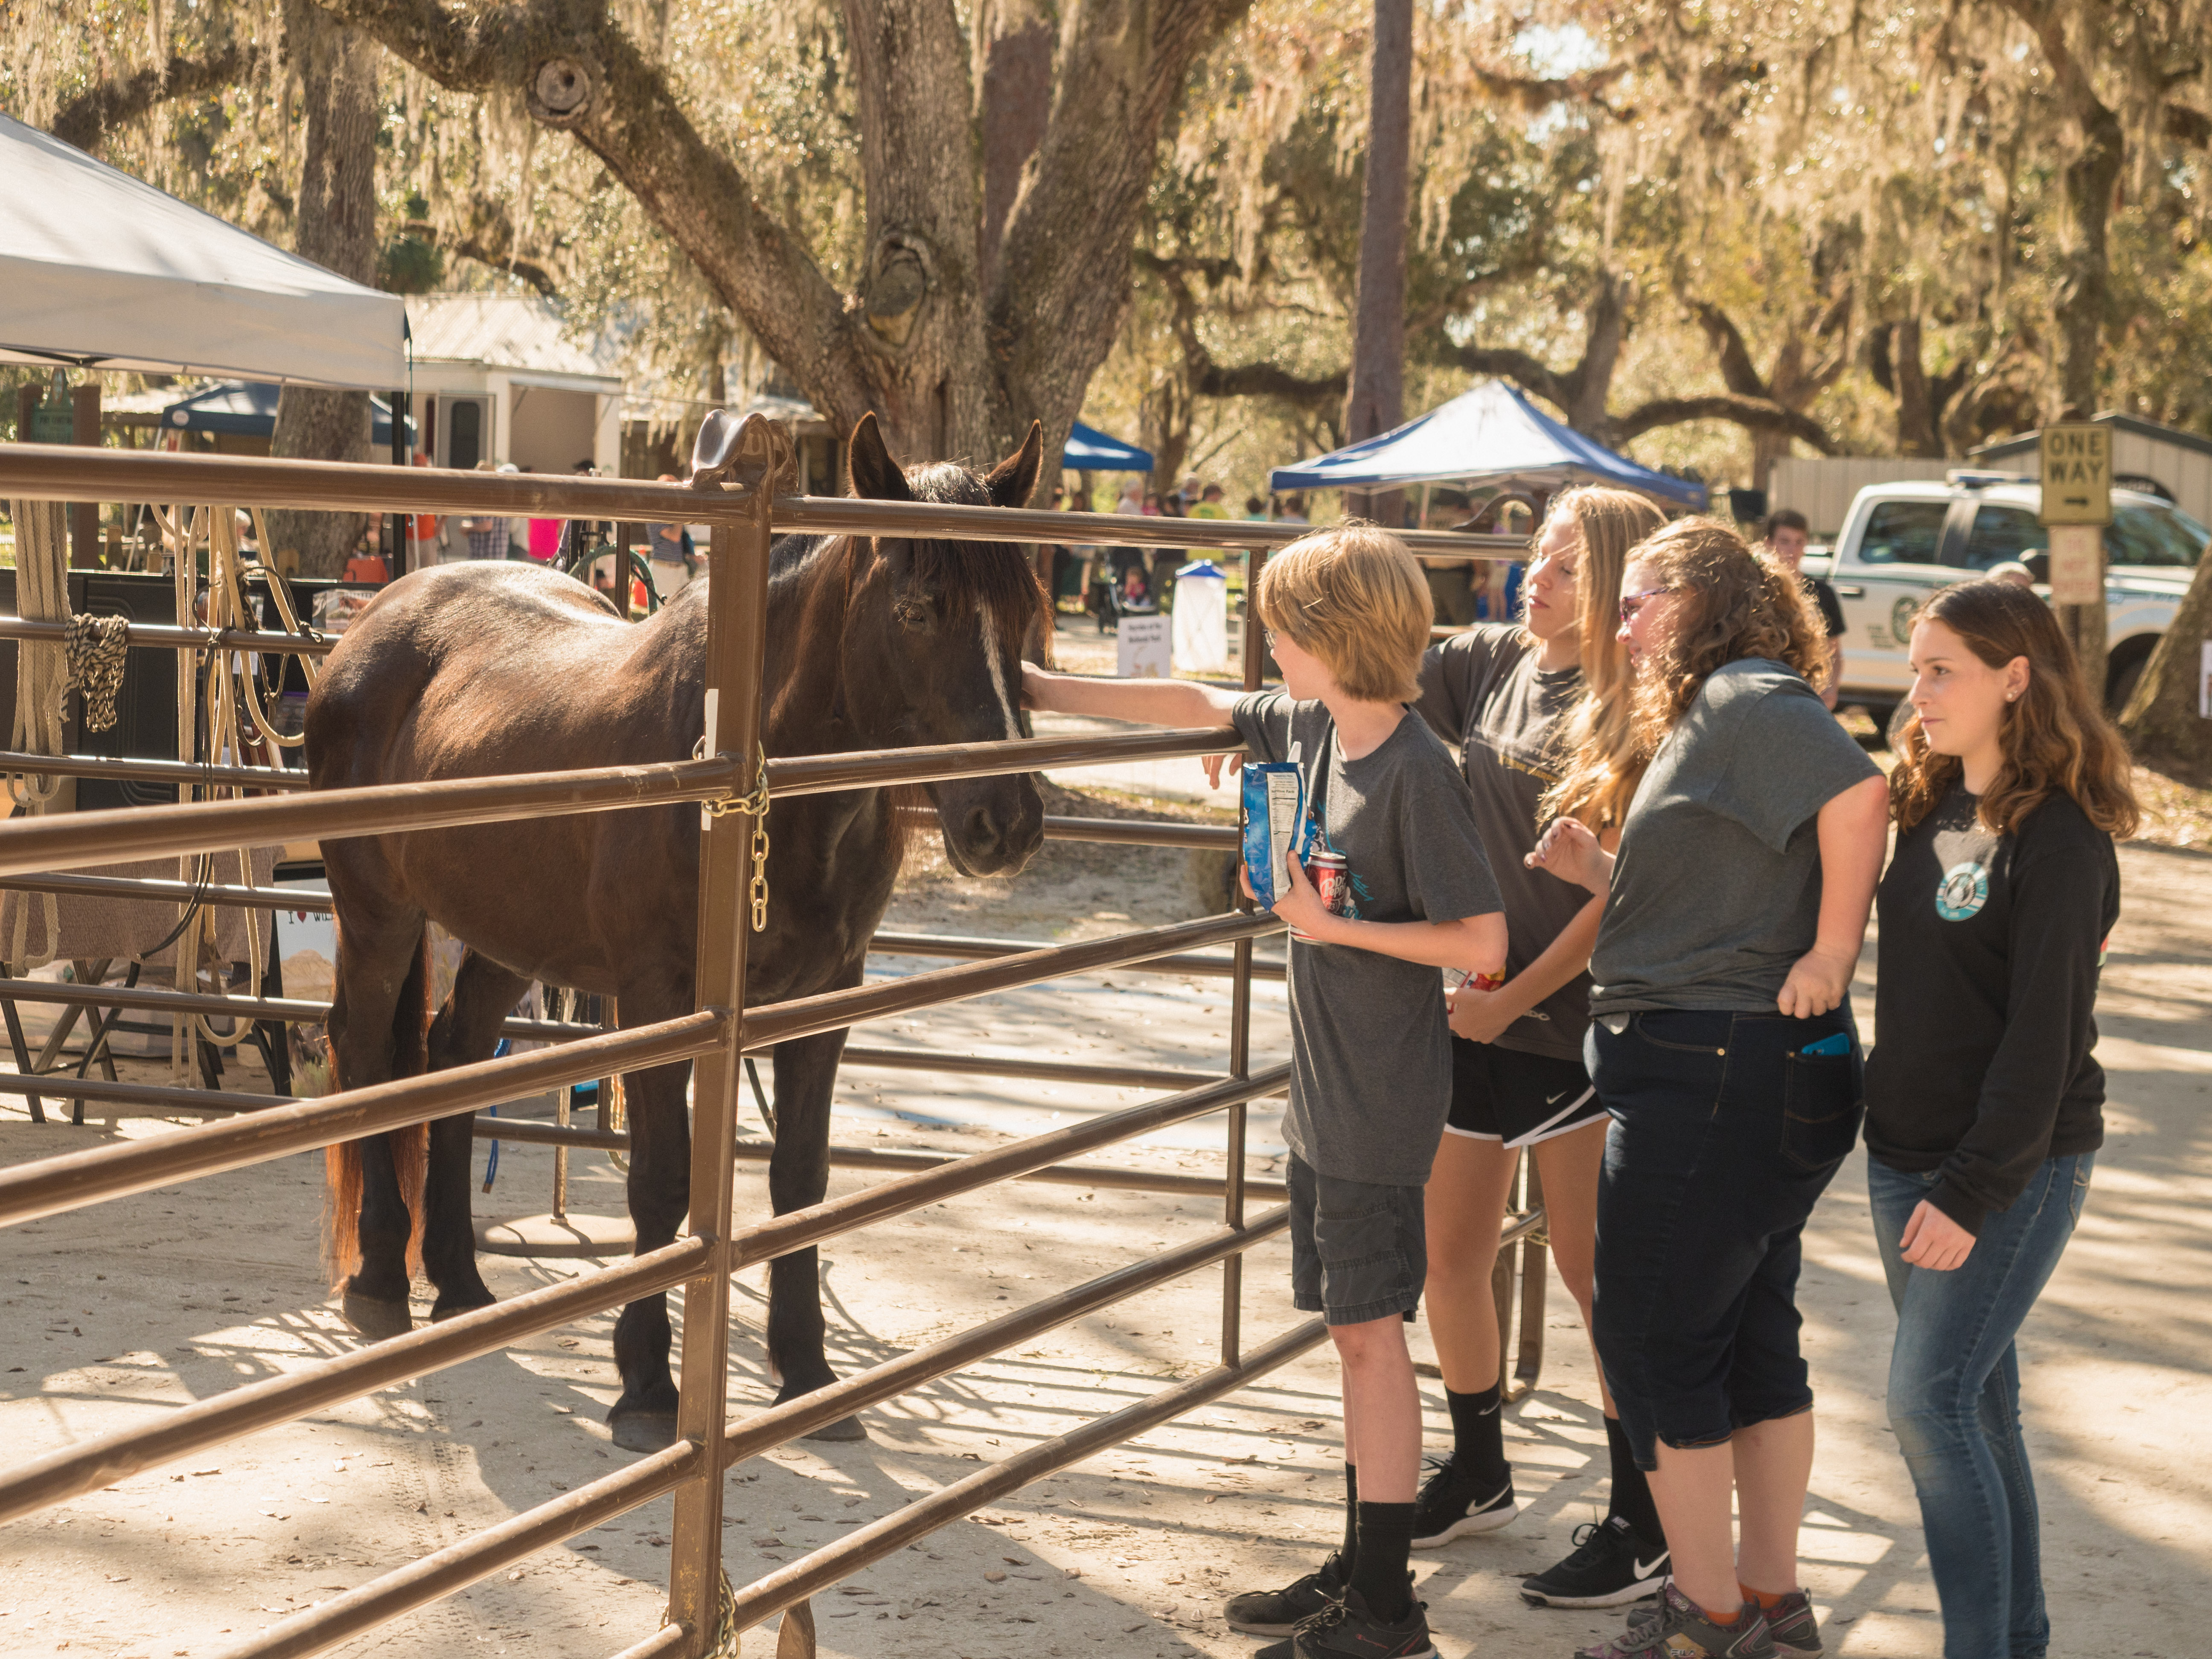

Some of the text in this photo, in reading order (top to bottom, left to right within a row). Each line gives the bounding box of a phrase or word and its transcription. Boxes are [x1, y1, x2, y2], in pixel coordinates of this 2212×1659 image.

[2049, 431, 2103, 456] ONE
[2049, 460, 2104, 483] WAY
[1328, 902, 1336, 910] 23
[288, 911, 294, 924] I
[1611, 1516, 1630, 1529] NIKE
[1671, 1649, 1697, 1658] FILA
